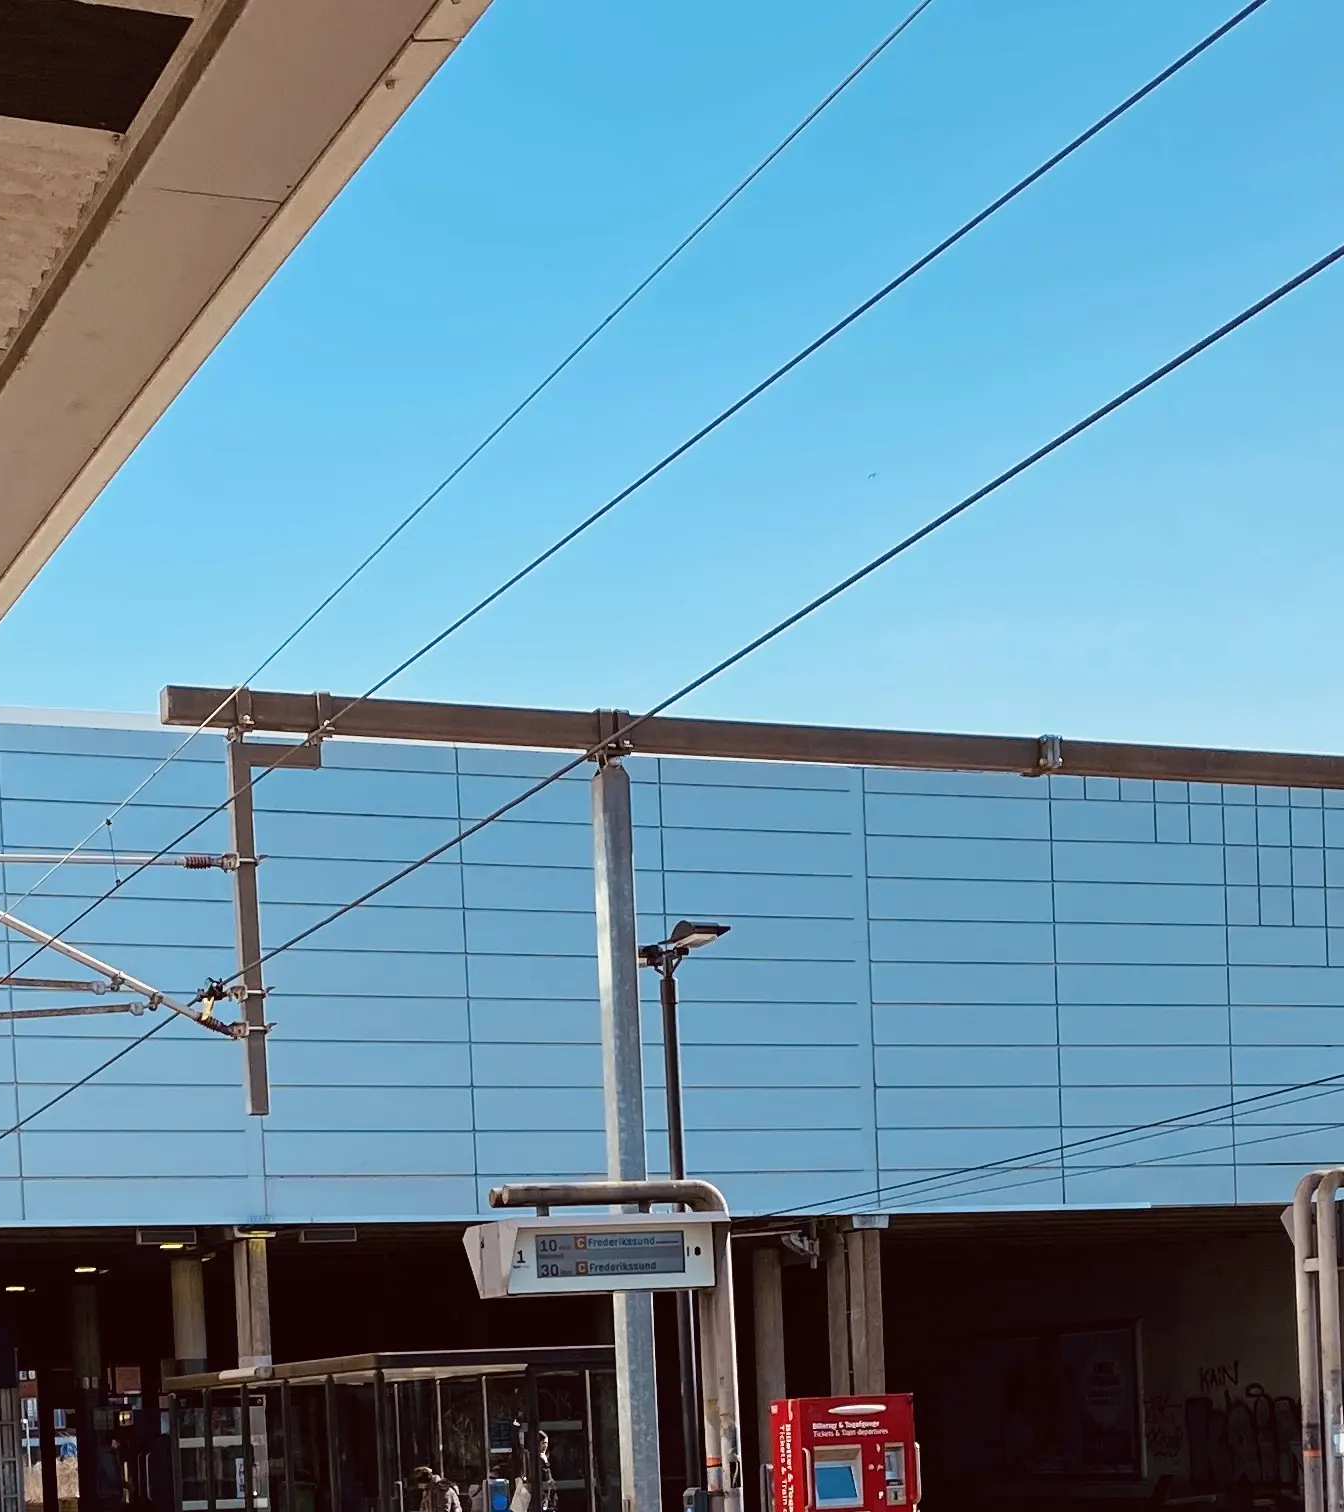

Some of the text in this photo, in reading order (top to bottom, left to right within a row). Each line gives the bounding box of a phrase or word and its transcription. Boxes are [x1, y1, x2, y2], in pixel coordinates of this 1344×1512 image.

[540, 1240, 557, 1252] 10
[588, 1237, 656, 1248] Frederikssund
[516, 1250, 526, 1264] 1
[540, 1264, 559, 1277] 30
[590, 1262, 657, 1272] Frederikssund
